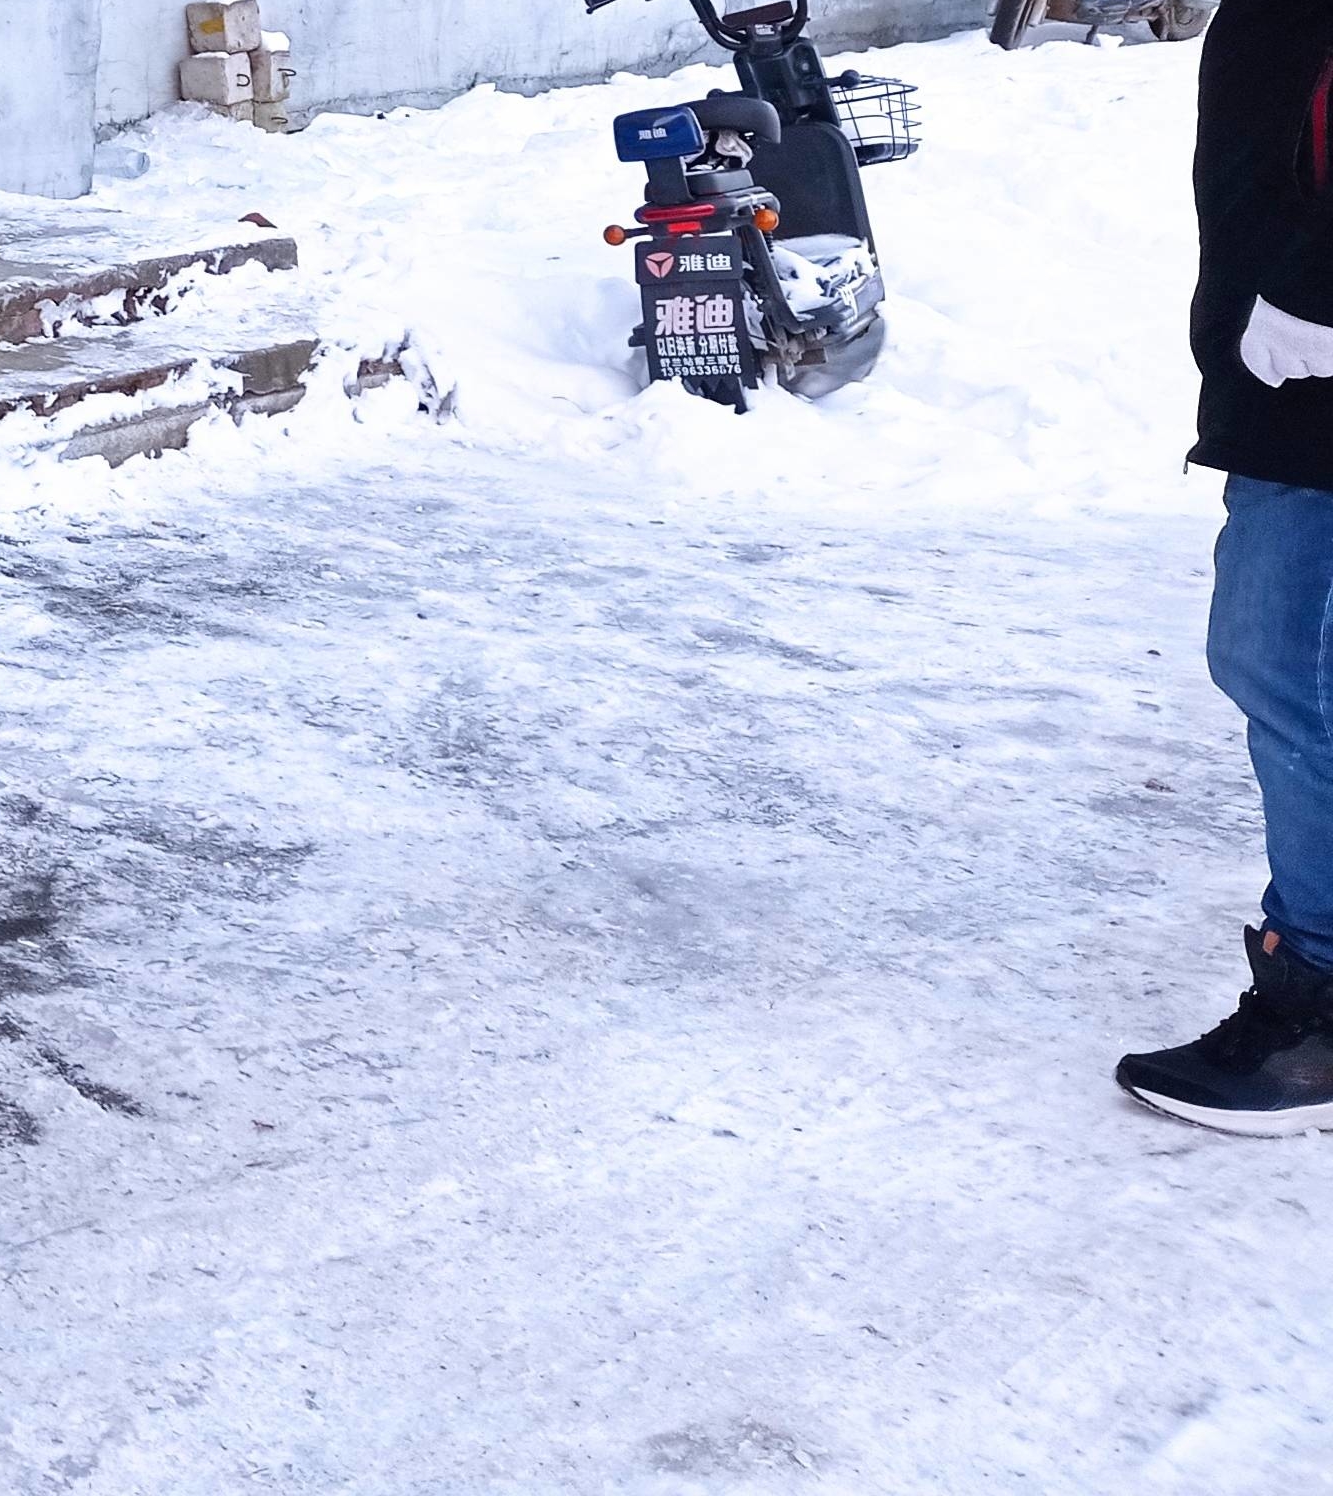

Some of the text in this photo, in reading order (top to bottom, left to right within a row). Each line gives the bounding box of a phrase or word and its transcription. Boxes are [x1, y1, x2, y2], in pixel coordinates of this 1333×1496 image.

[678, 254, 733, 272] 雅迪
[654, 293, 735, 336] 雅迪
[656, 333, 739, 357] 以旧换新 分期付款
